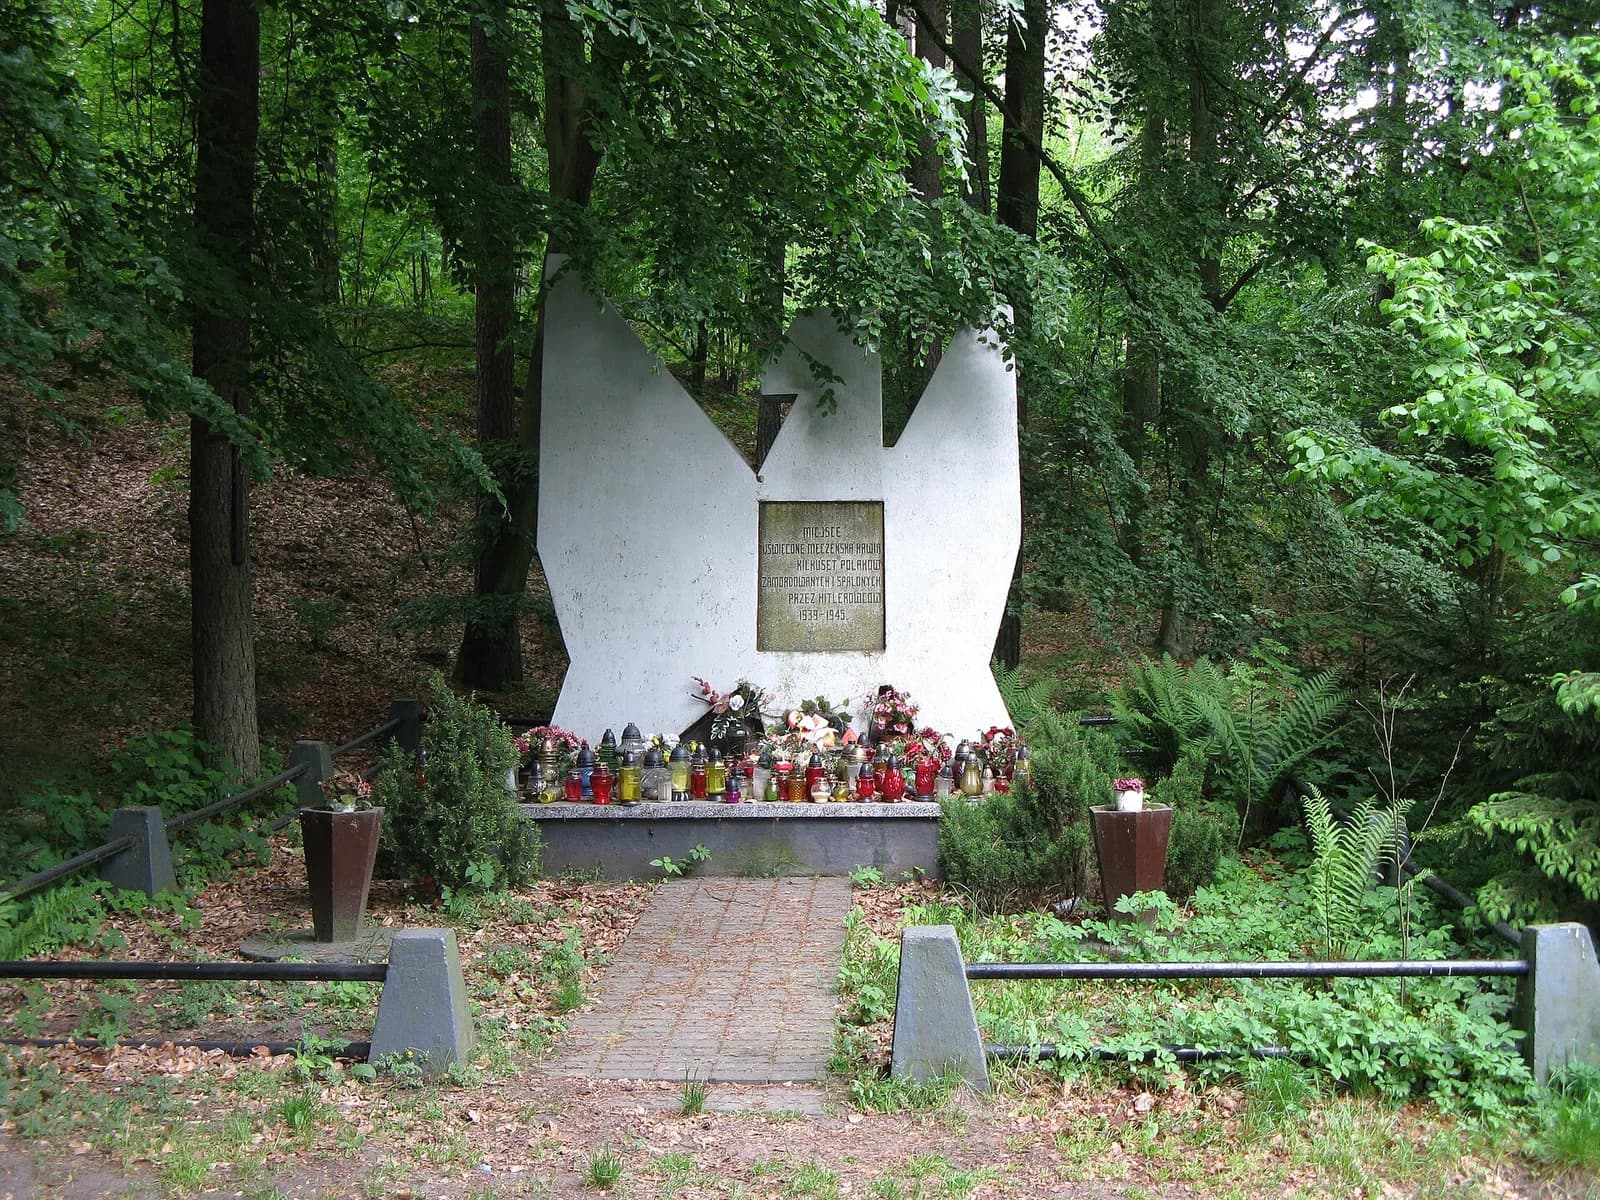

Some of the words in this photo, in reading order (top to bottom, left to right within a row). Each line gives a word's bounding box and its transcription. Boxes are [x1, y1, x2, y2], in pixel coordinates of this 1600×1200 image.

[803, 526, 841, 538] MIEJSCE
[797, 559, 837, 571] KILKUSET
[761, 576, 830, 588] ZAMORDOWANYCH
[831, 576, 835, 587] I
[836, 576, 881, 587] SPALONYCH
[788, 592, 816, 604] PRZEZ
